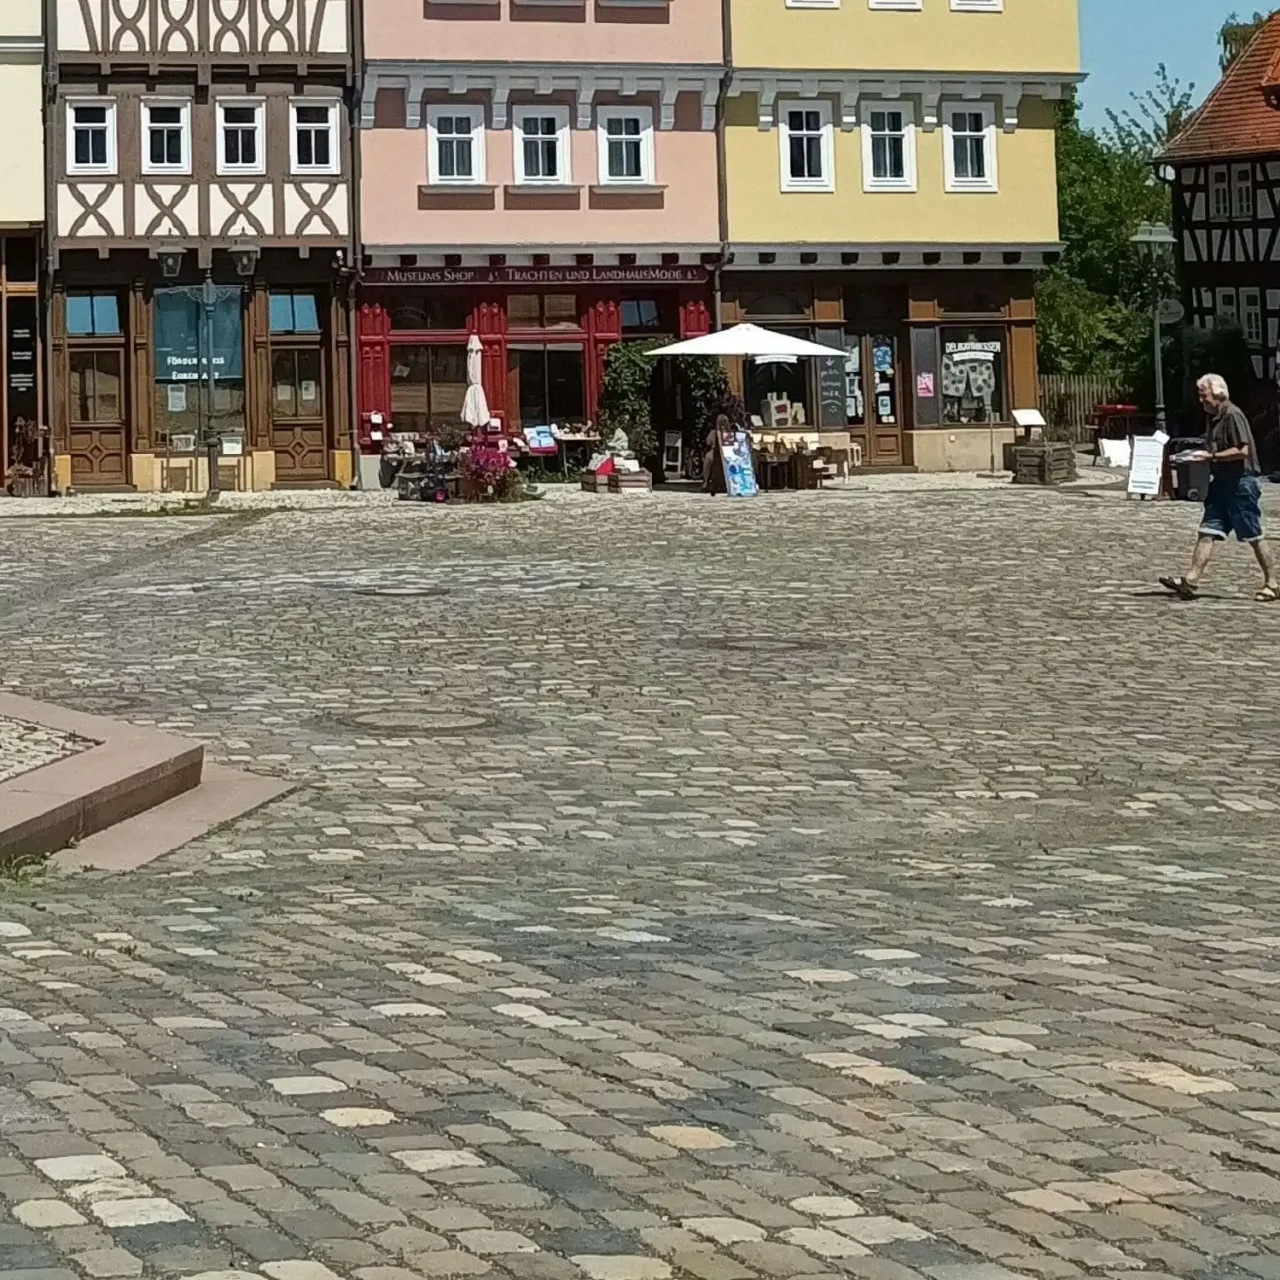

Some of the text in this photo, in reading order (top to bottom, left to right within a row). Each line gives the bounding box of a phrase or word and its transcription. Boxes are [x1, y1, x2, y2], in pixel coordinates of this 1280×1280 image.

[386, 269, 442, 282] MUSEUMS
[443, 268, 475, 282] SHOP
[506, 268, 562, 282] TRACHTEN
[566, 269, 589, 281] UND
